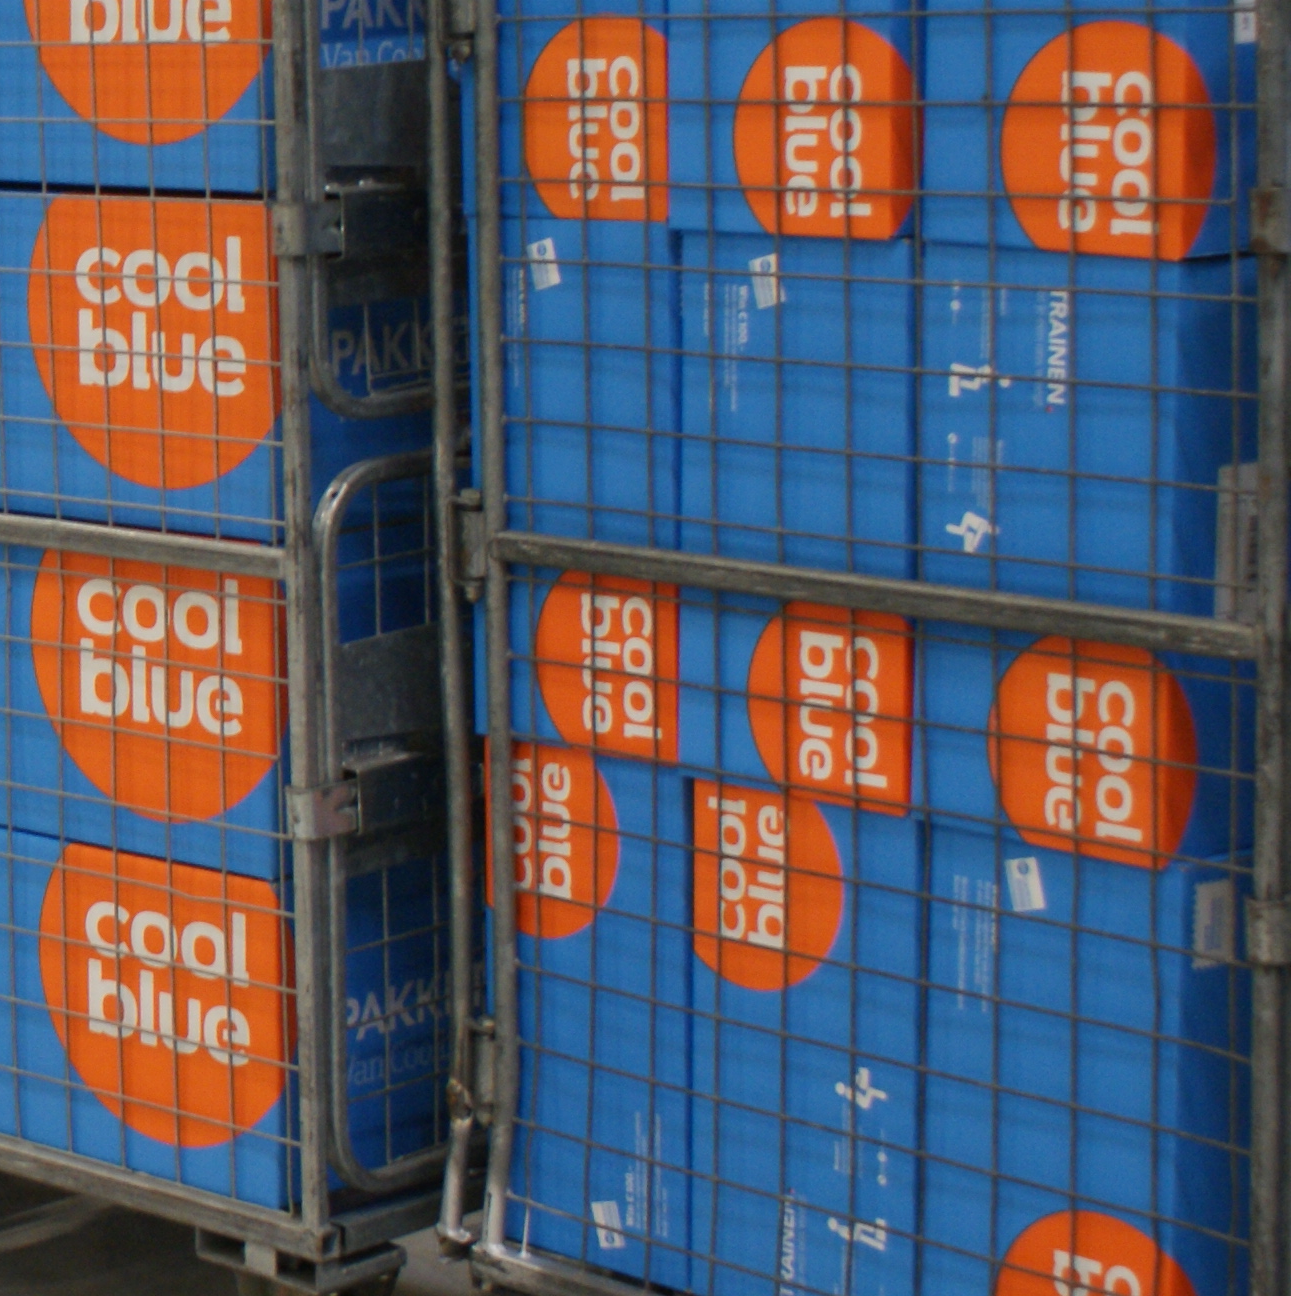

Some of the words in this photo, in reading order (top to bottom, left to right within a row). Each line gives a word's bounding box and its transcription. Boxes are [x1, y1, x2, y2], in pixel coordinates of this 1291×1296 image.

[568, 58, 606, 202] blue
[610, 54, 644, 202] cool
[787, 65, 828, 220] blue
[830, 64, 872, 220] cool
[1059, 71, 1112, 235] blue
[1110, 70, 1154, 237] cool
[75, 236, 246, 313] cool
[77, 310, 246, 397] blue
[77, 578, 243, 656] cool
[79, 637, 243, 737] blue
[580, 593, 621, 736] blue
[621, 595, 662, 741] cool
[798, 630, 844, 783] blue
[844, 636, 888, 791] cool
[1044, 671, 1097, 833] blue
[1096, 679, 1143, 843] cool
[538, 762, 572, 900] blue
[707, 796, 747, 940] cool
[747, 804, 787, 950] blue
[84, 900, 250, 989] cool
[87, 958, 251, 1068] blue
